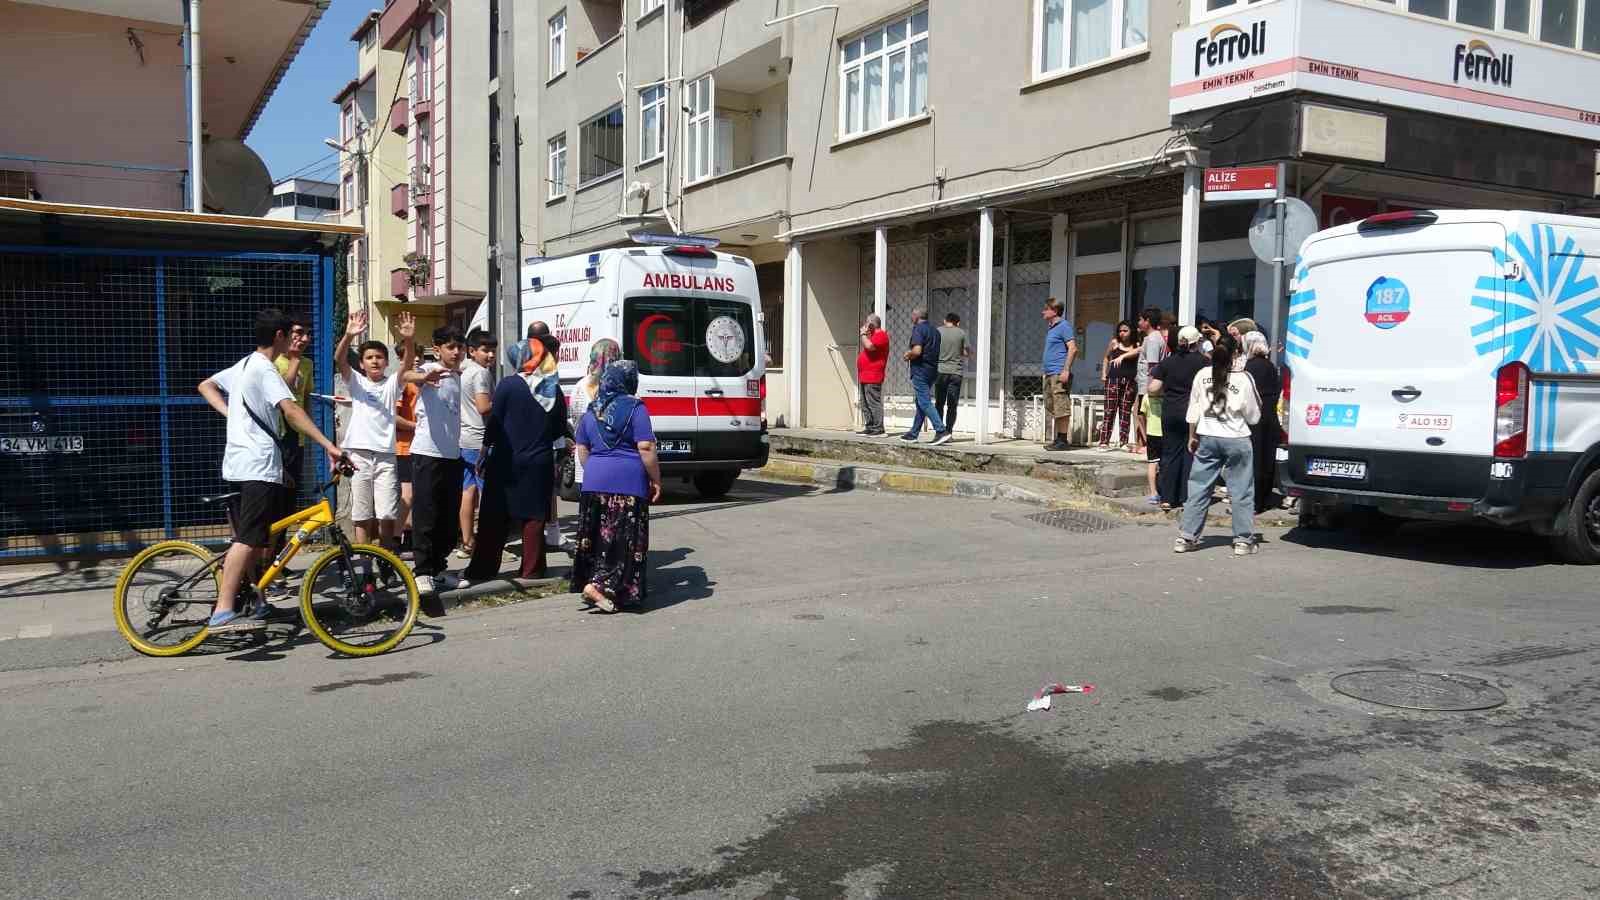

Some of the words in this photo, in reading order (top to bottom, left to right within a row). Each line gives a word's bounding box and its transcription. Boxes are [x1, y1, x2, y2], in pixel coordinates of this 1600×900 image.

[1195, 20, 1266, 77] Ferroli
[1453, 43, 1513, 88] Ferroli
[1208, 171, 1237, 183] ALİZE
[643, 273, 735, 292] AMBULANS
[1375, 288, 1406, 304] 187
[1410, 418, 1431, 426] ALO
[4, 438, 20, 452] 34
[26, 438, 48, 451] VM
